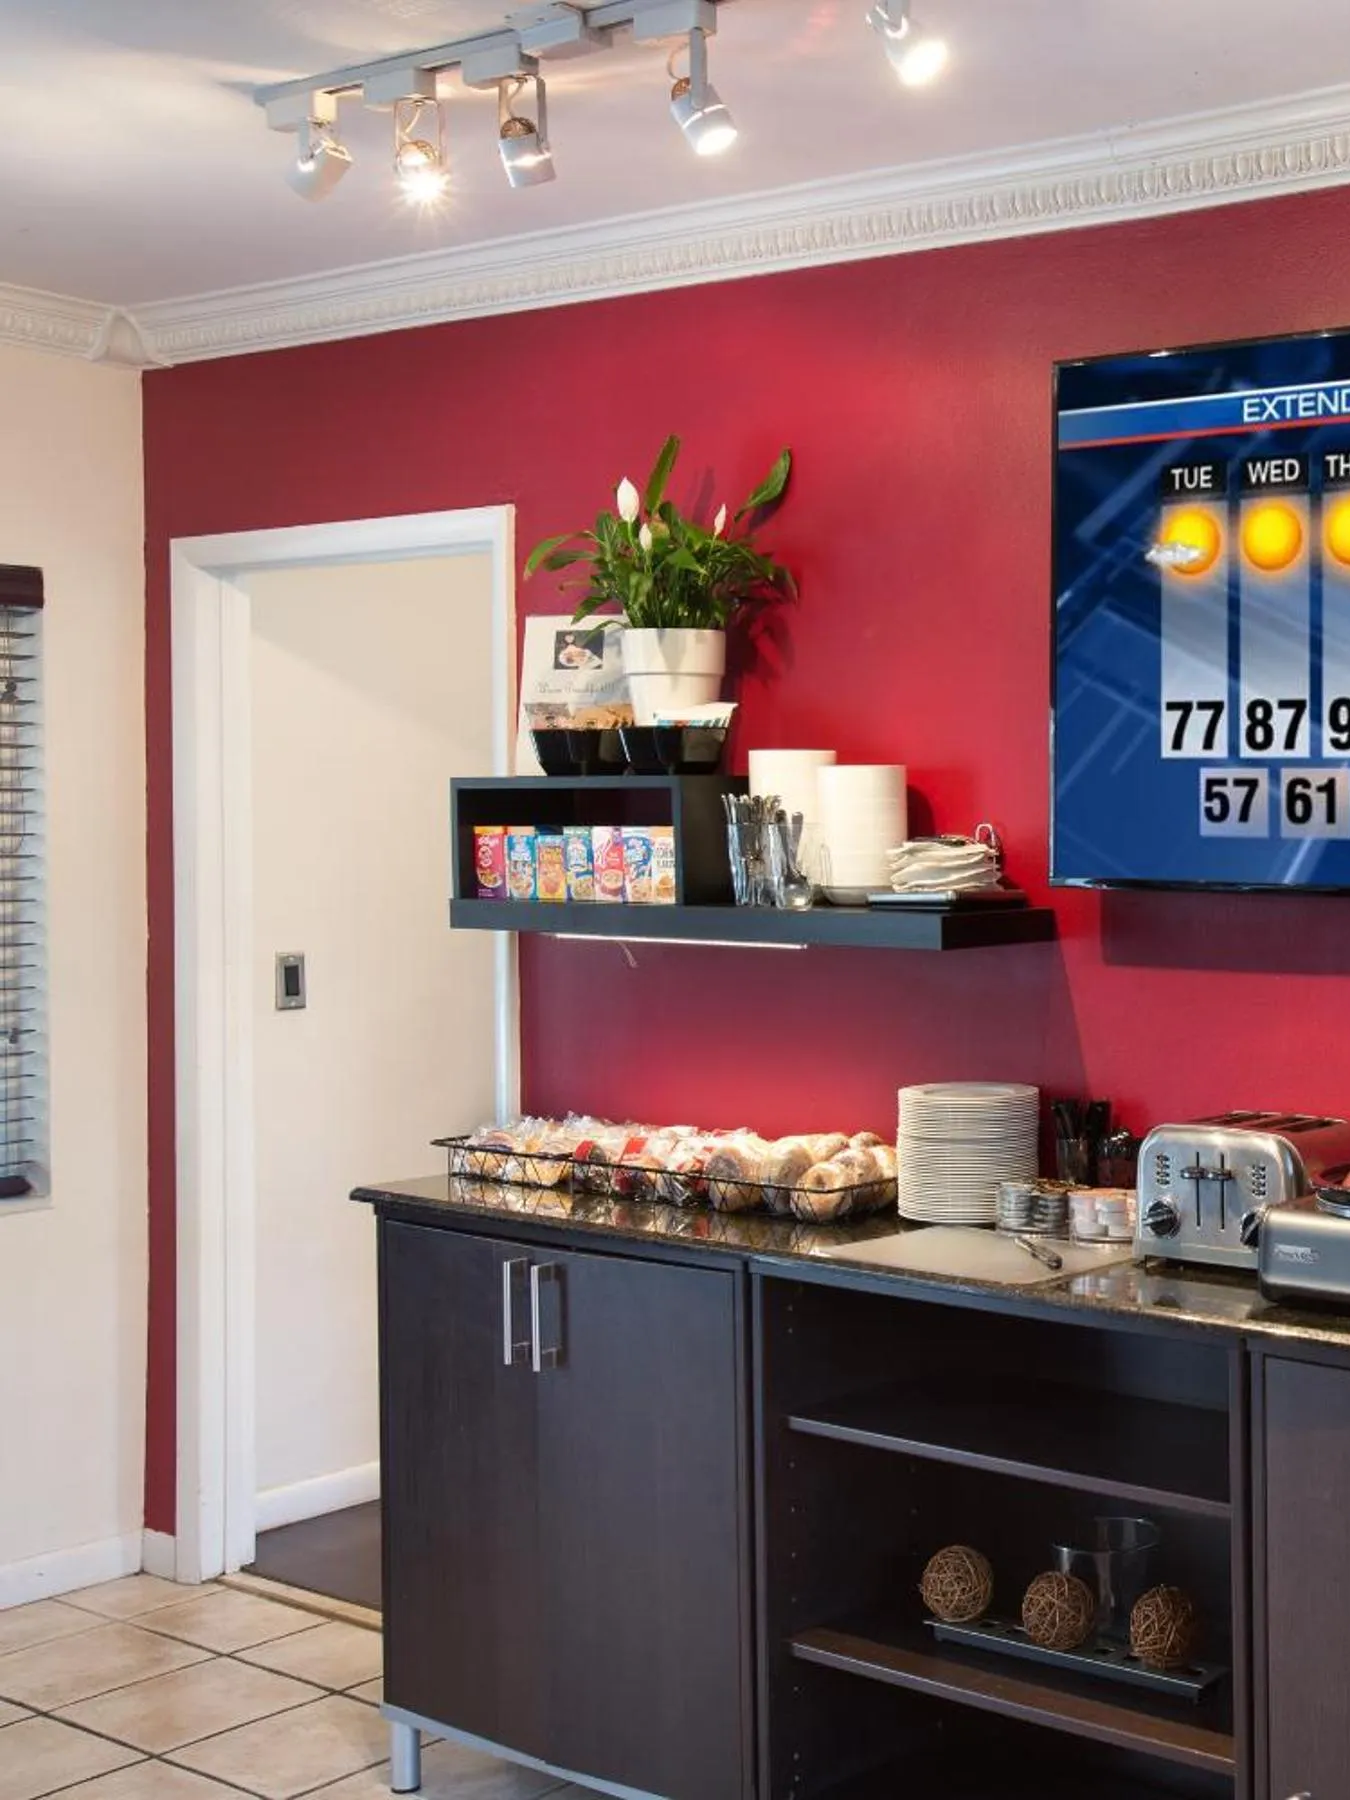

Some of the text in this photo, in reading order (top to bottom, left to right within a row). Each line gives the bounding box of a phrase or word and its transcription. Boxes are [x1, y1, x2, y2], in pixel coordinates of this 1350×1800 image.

[1171, 466, 1212, 489] TUE
[1248, 459, 1300, 483] WED
[1166, 701, 1225, 751] 77
[1245, 699, 1307, 751] 87
[1204, 778, 1259, 823] 57
[1286, 777, 1336, 825] 61
